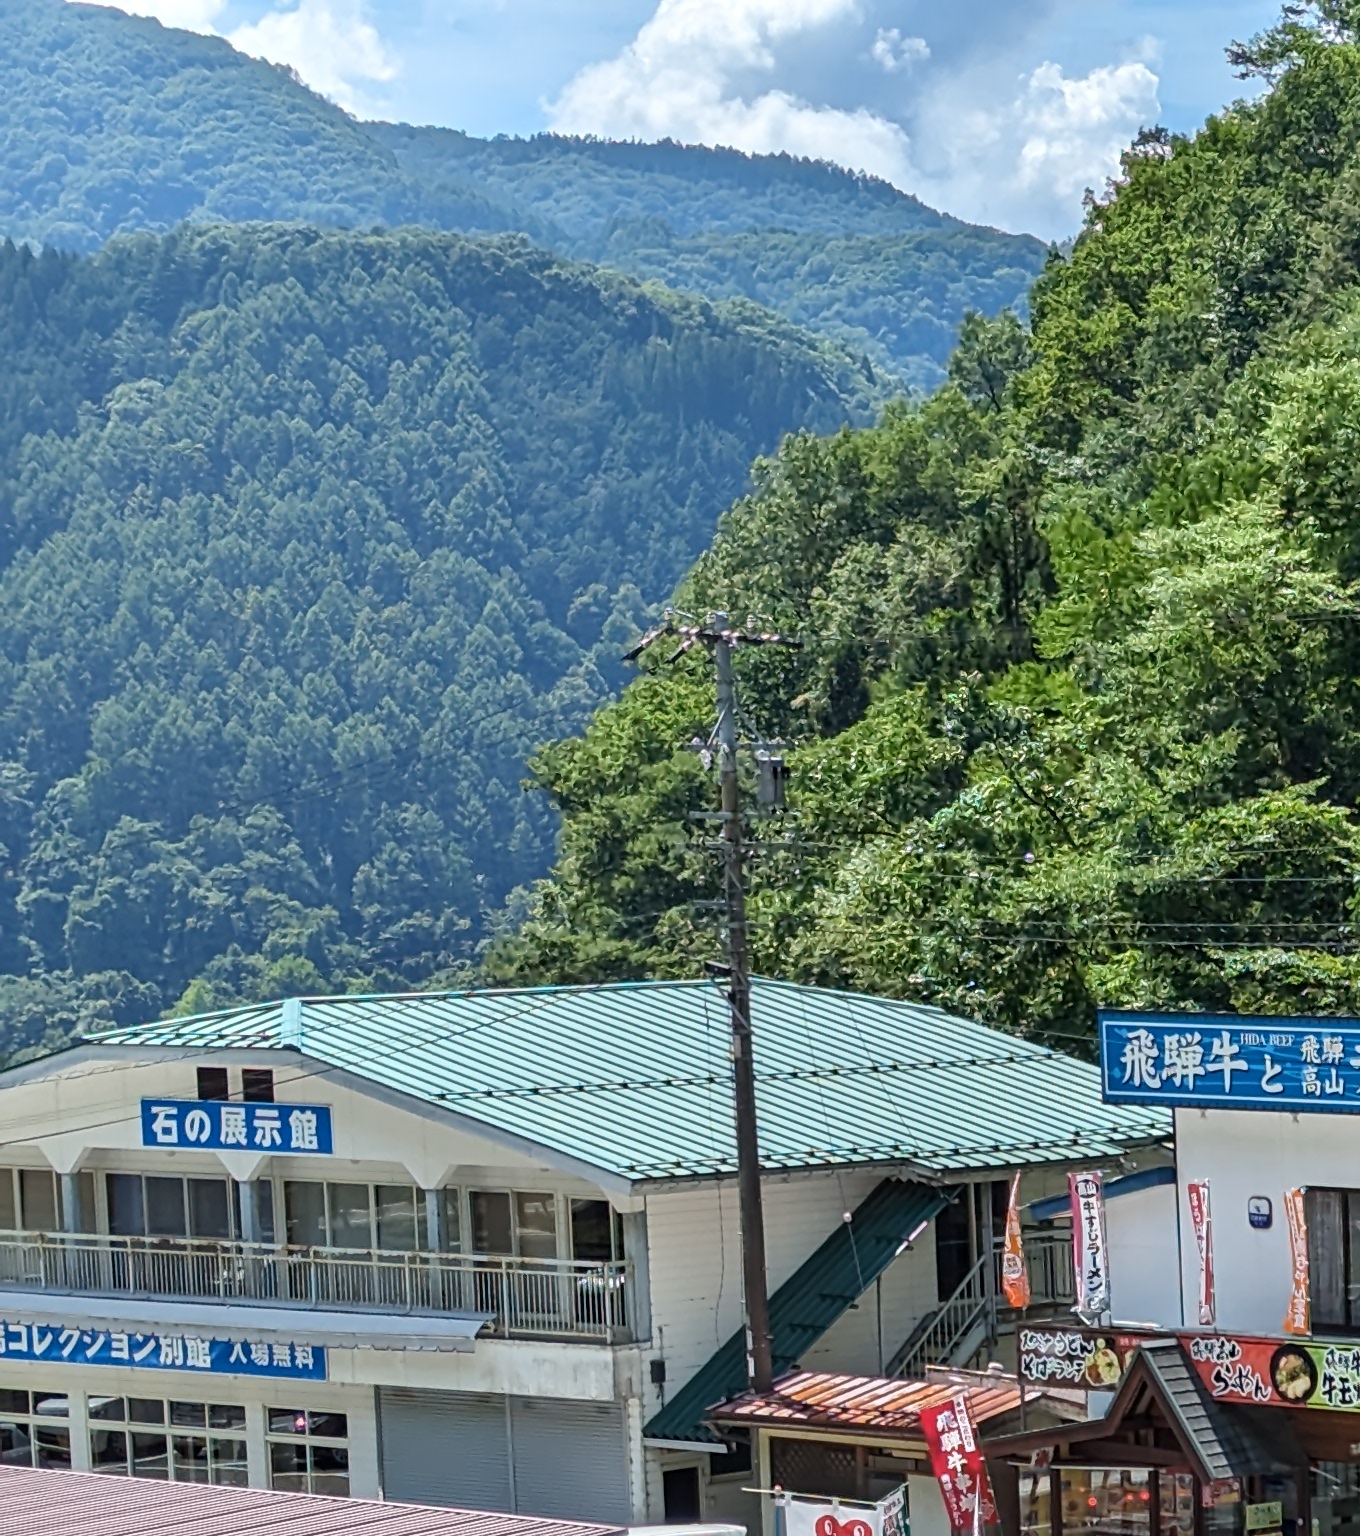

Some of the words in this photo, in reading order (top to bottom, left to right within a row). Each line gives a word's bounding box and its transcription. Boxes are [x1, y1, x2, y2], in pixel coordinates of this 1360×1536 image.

[1240, 1032, 1267, 1046] HIDA
[1269, 1034, 1295, 1047] BEEF
[151, 1105, 320, 1150] 石の展示館
[229, 1345, 314, 1370] 入場無料
